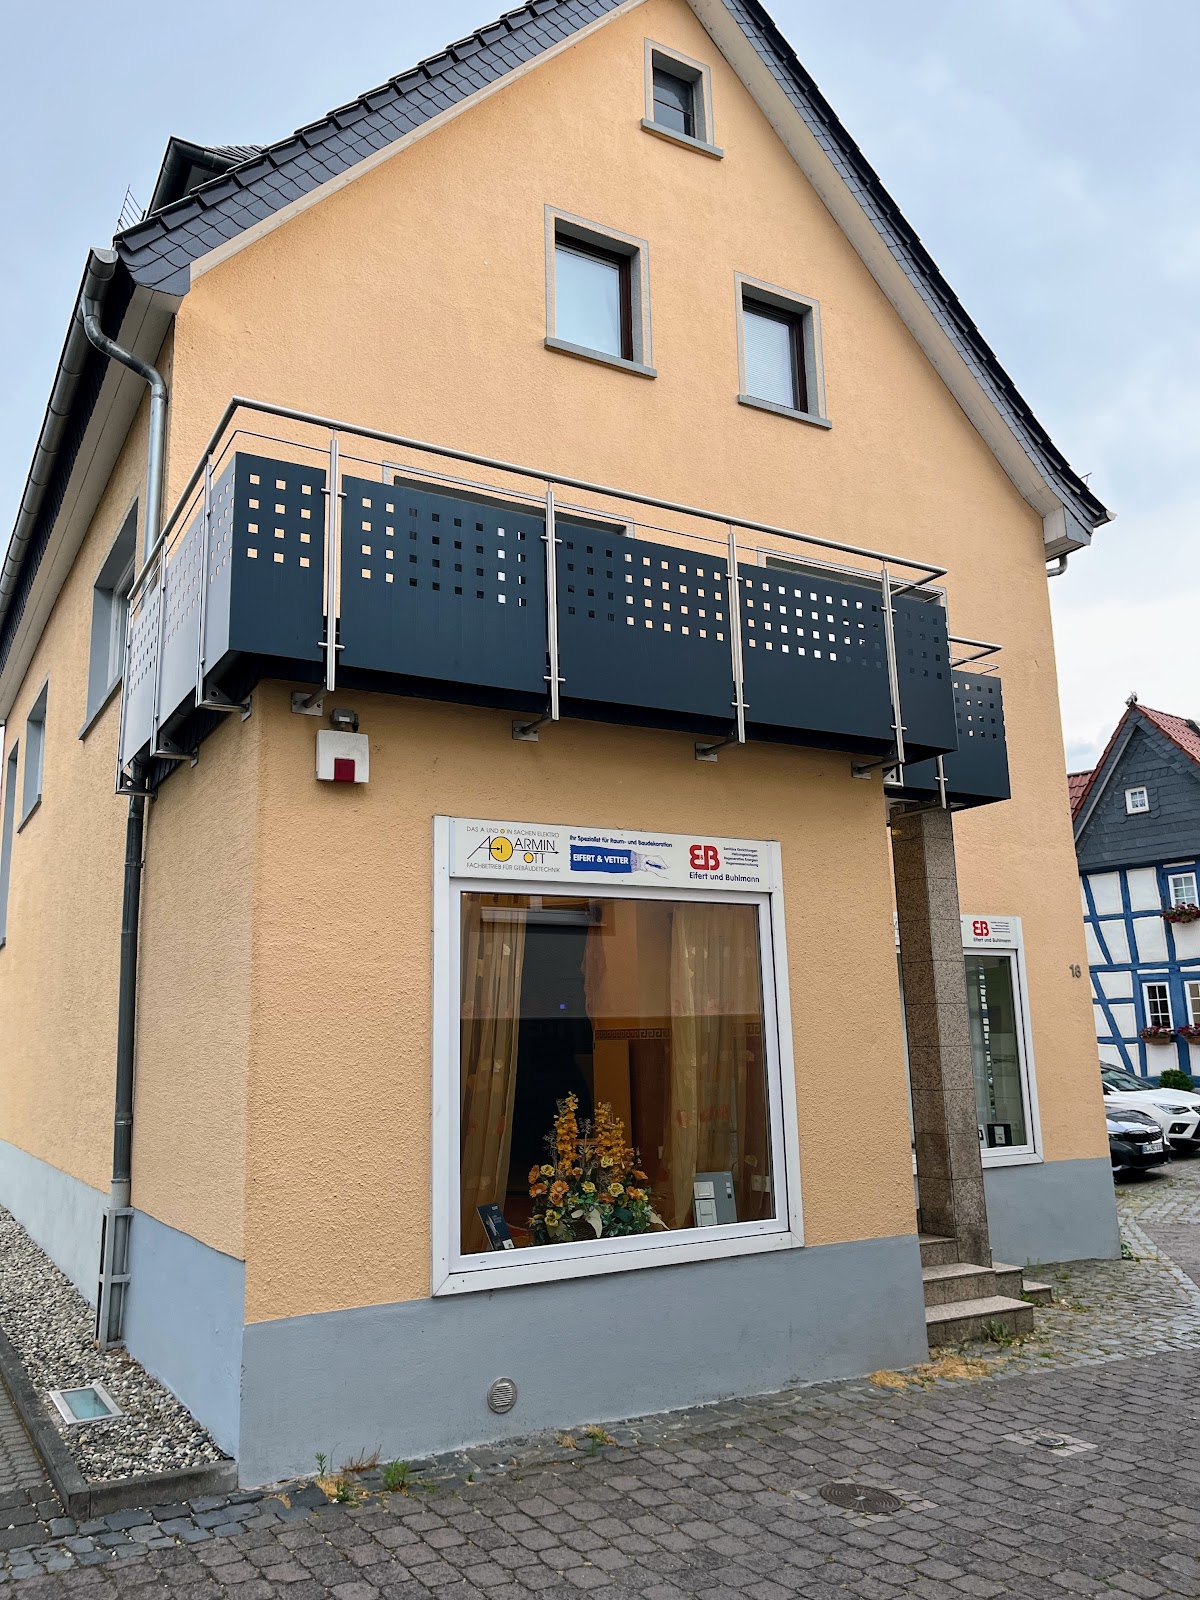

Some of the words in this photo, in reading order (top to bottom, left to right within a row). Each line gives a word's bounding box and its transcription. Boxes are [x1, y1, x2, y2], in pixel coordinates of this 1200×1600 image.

[514, 837, 555, 851] ARMIN
[577, 835, 601, 843] Spezialist
[638, 839, 673, 847] Baudekoration
[572, 853, 595, 862] EIFERT
[596, 855, 603, 863] &
[604, 855, 629, 864] VETTER
[502, 863, 513, 871] FÜR
[513, 864, 561, 873] GEBÄUDETECHNIK
[689, 871, 709, 880] Eifert
[709, 873, 724, 881] und
[725, 874, 760, 883] Buhlmann
